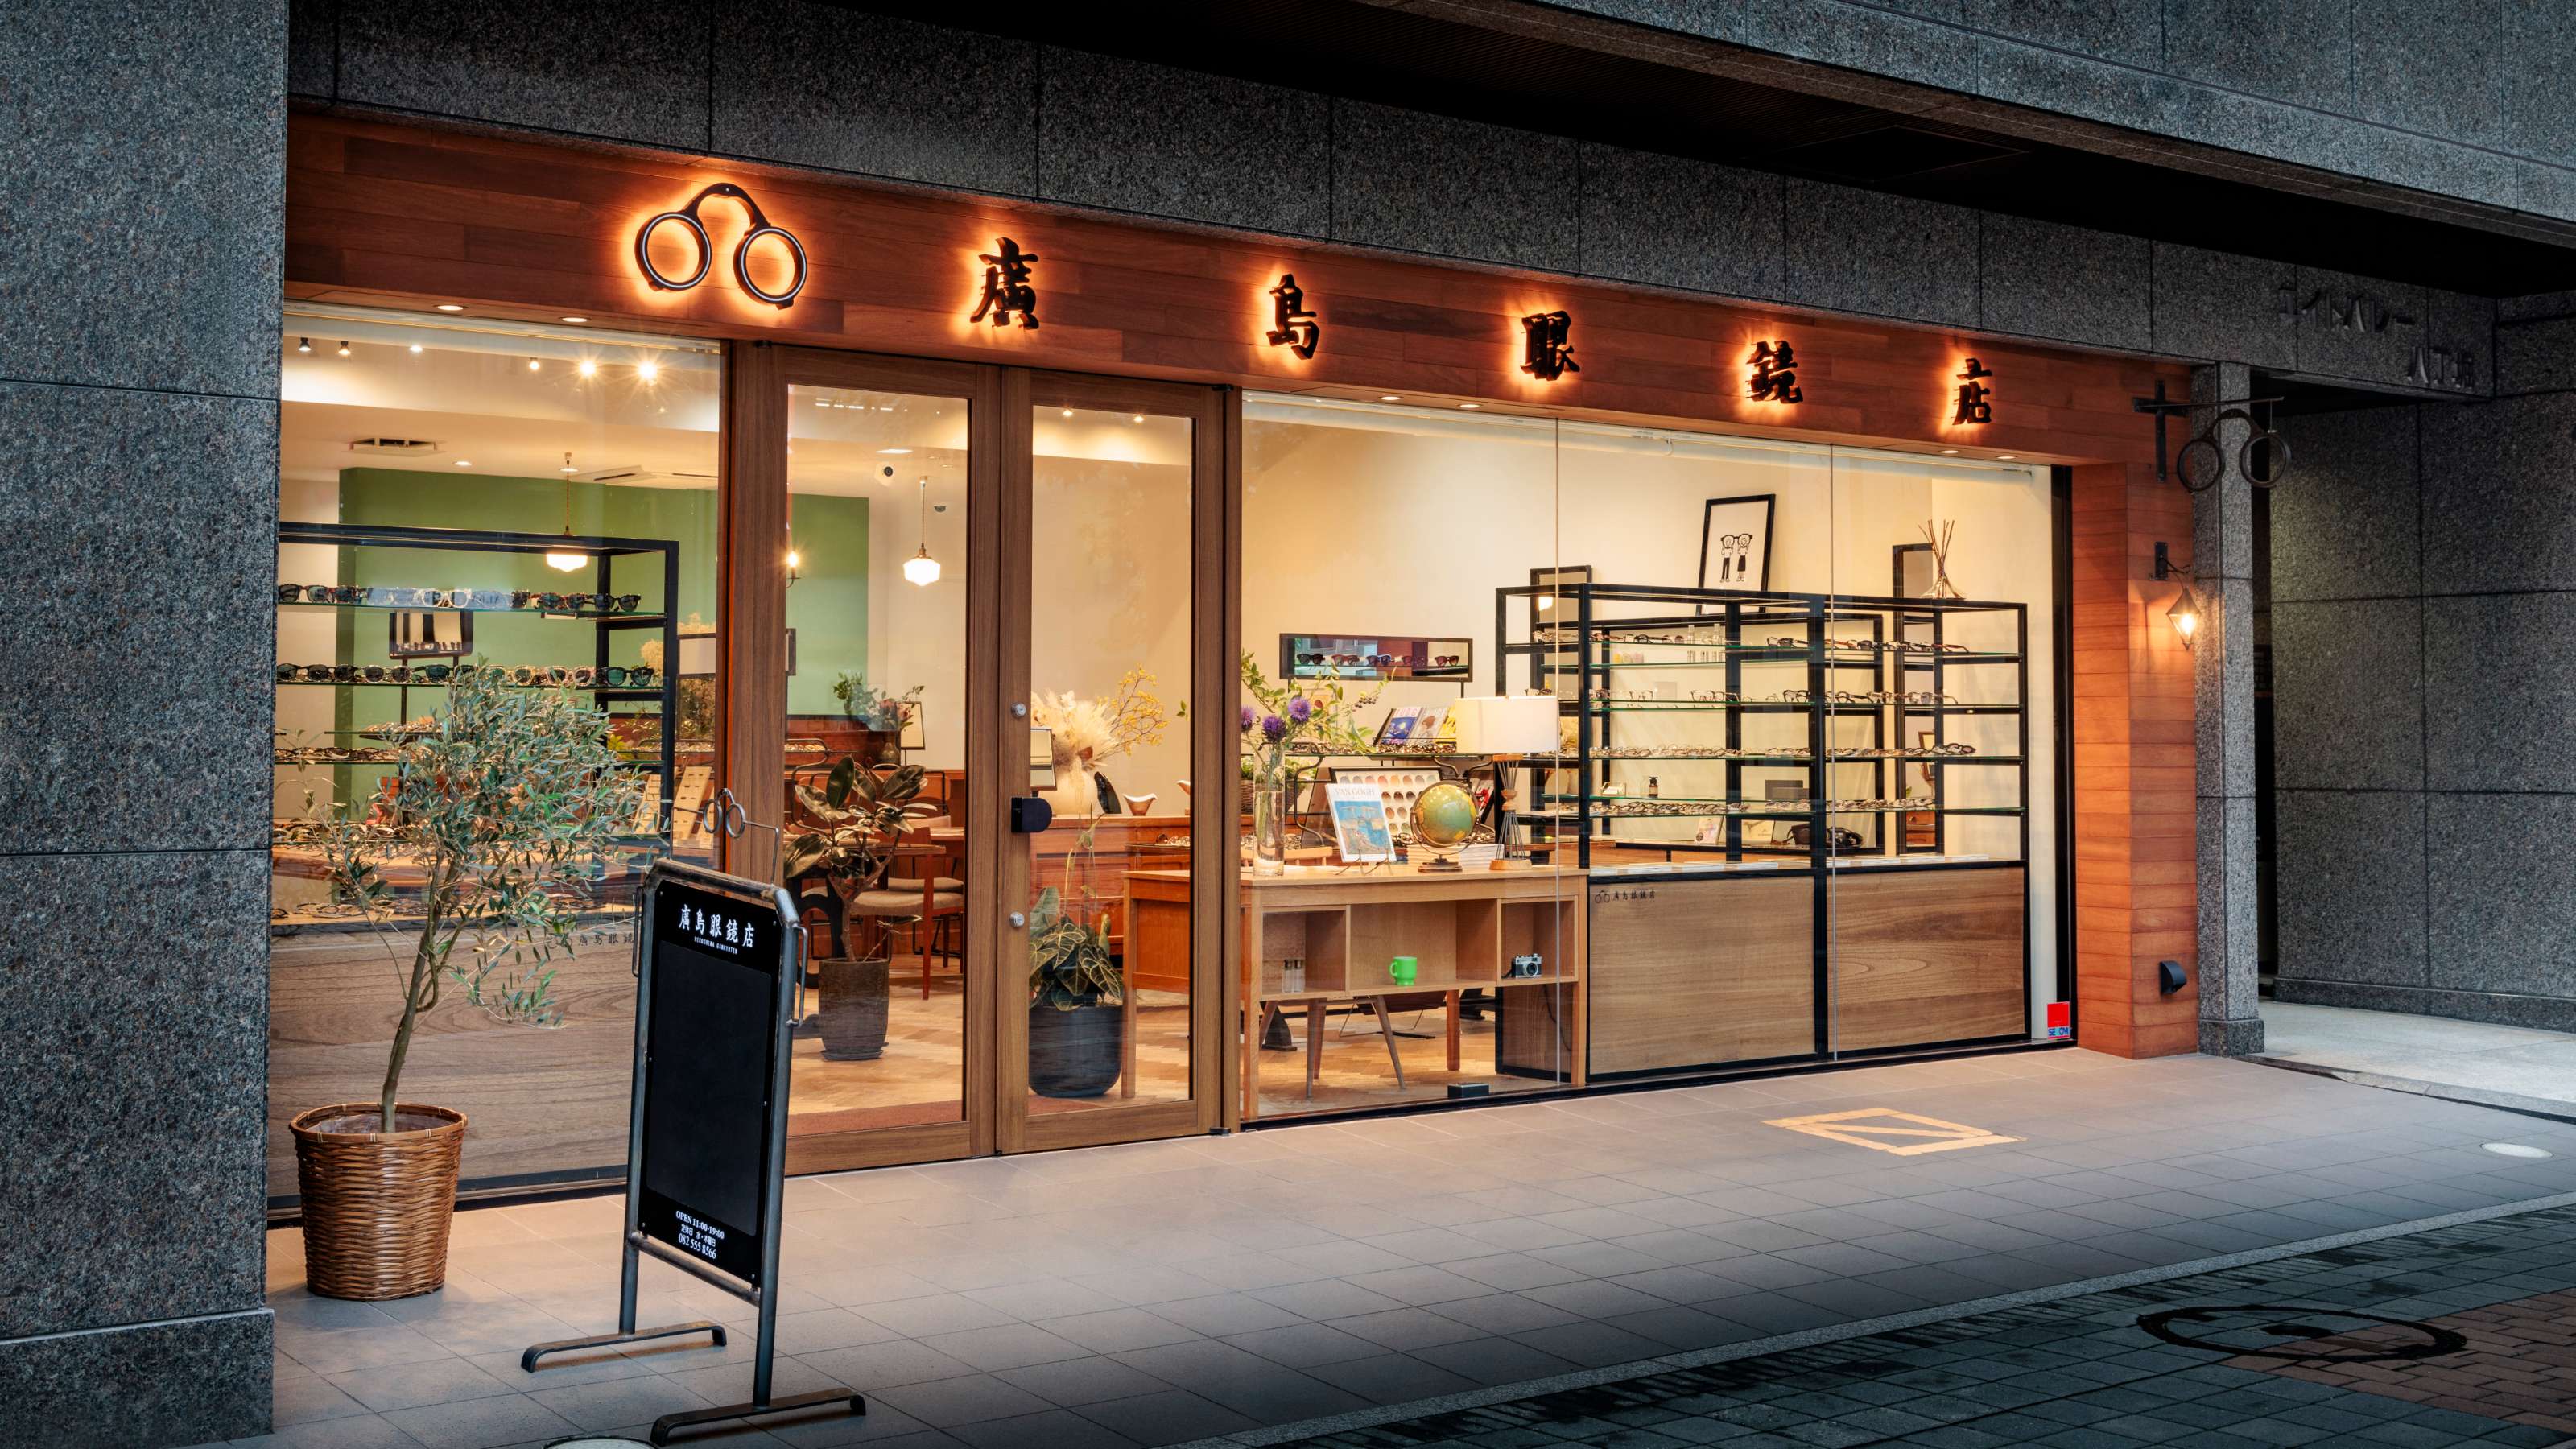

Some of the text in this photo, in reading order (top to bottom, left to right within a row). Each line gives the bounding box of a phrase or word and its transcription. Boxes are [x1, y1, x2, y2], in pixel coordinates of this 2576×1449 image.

[970, 237, 1992, 427] 廣島眼鏡店
[679, 903, 755, 947] 廣島眼鏡店
[675, 1211, 724, 1239] OPEN 11:00-19:00
[679, 1233, 716, 1259] 082 555 8566
